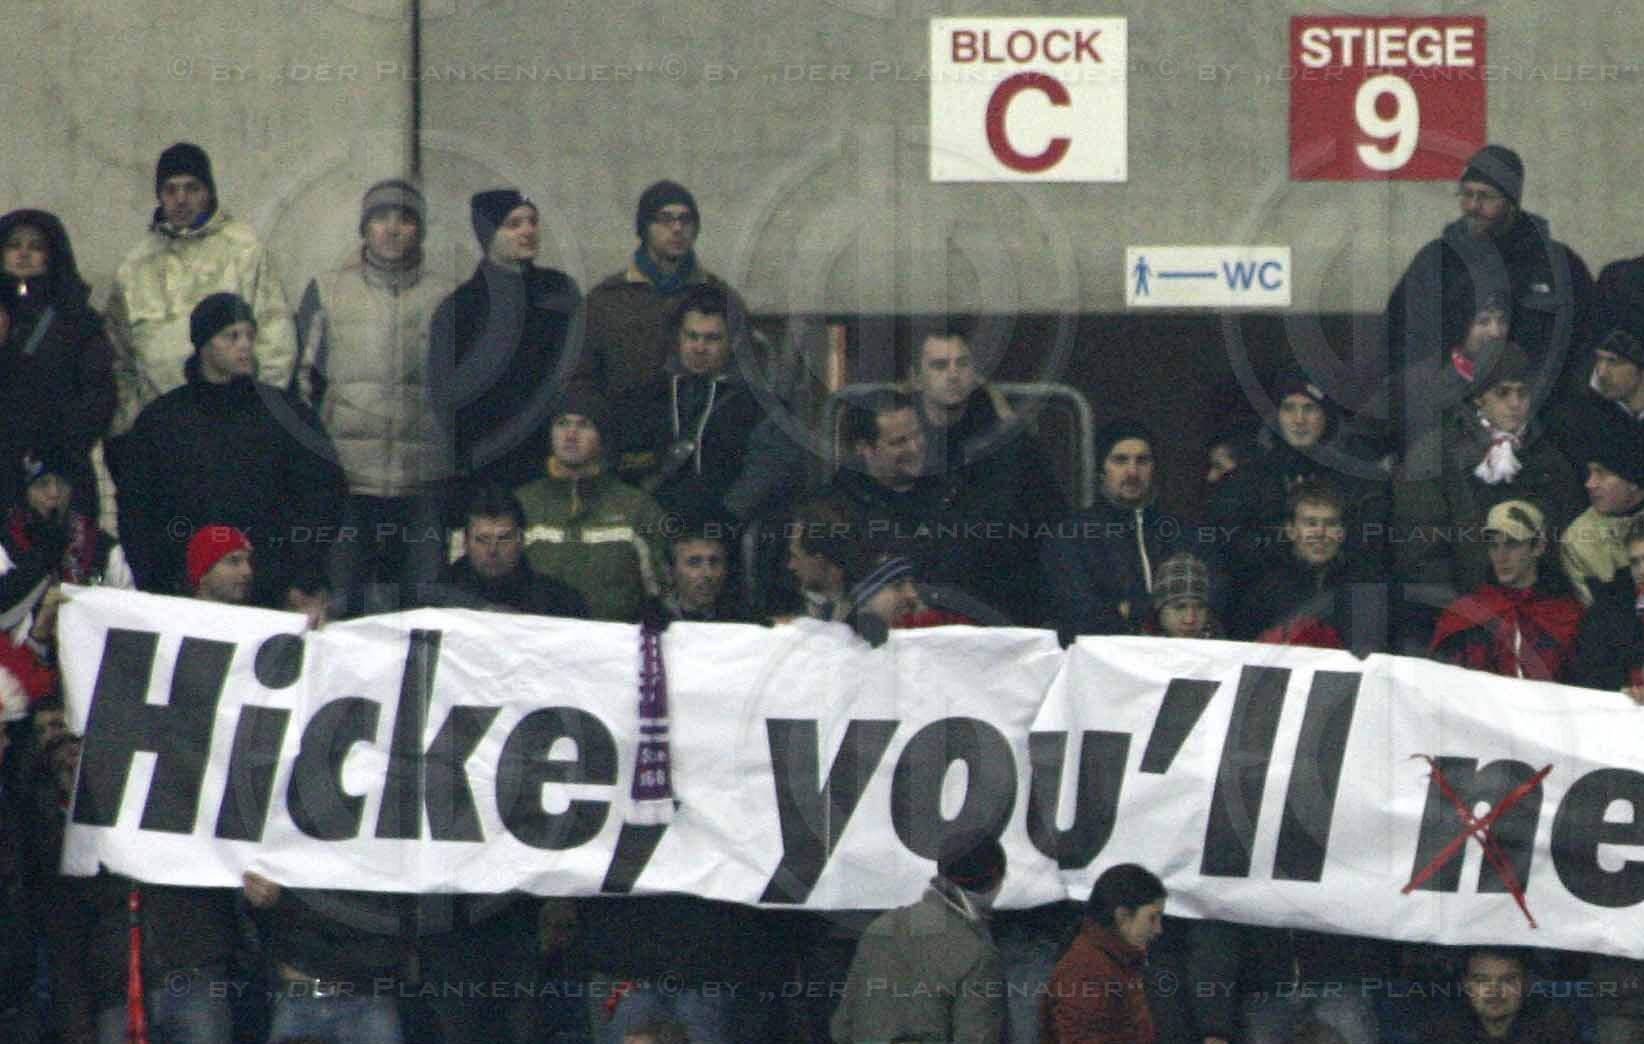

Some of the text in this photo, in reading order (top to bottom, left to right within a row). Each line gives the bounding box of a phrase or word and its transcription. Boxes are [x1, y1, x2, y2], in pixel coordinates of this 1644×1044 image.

[951, 29, 1104, 65] BLOCK
[1300, 26, 1475, 69] STIEGE
[984, 71, 1073, 174] C
[1353, 73, 1422, 172] 9
[1222, 260, 1284, 292] WC
[72, 627, 679, 894] Hicke,
[759, 665, 1362, 905] you'll
